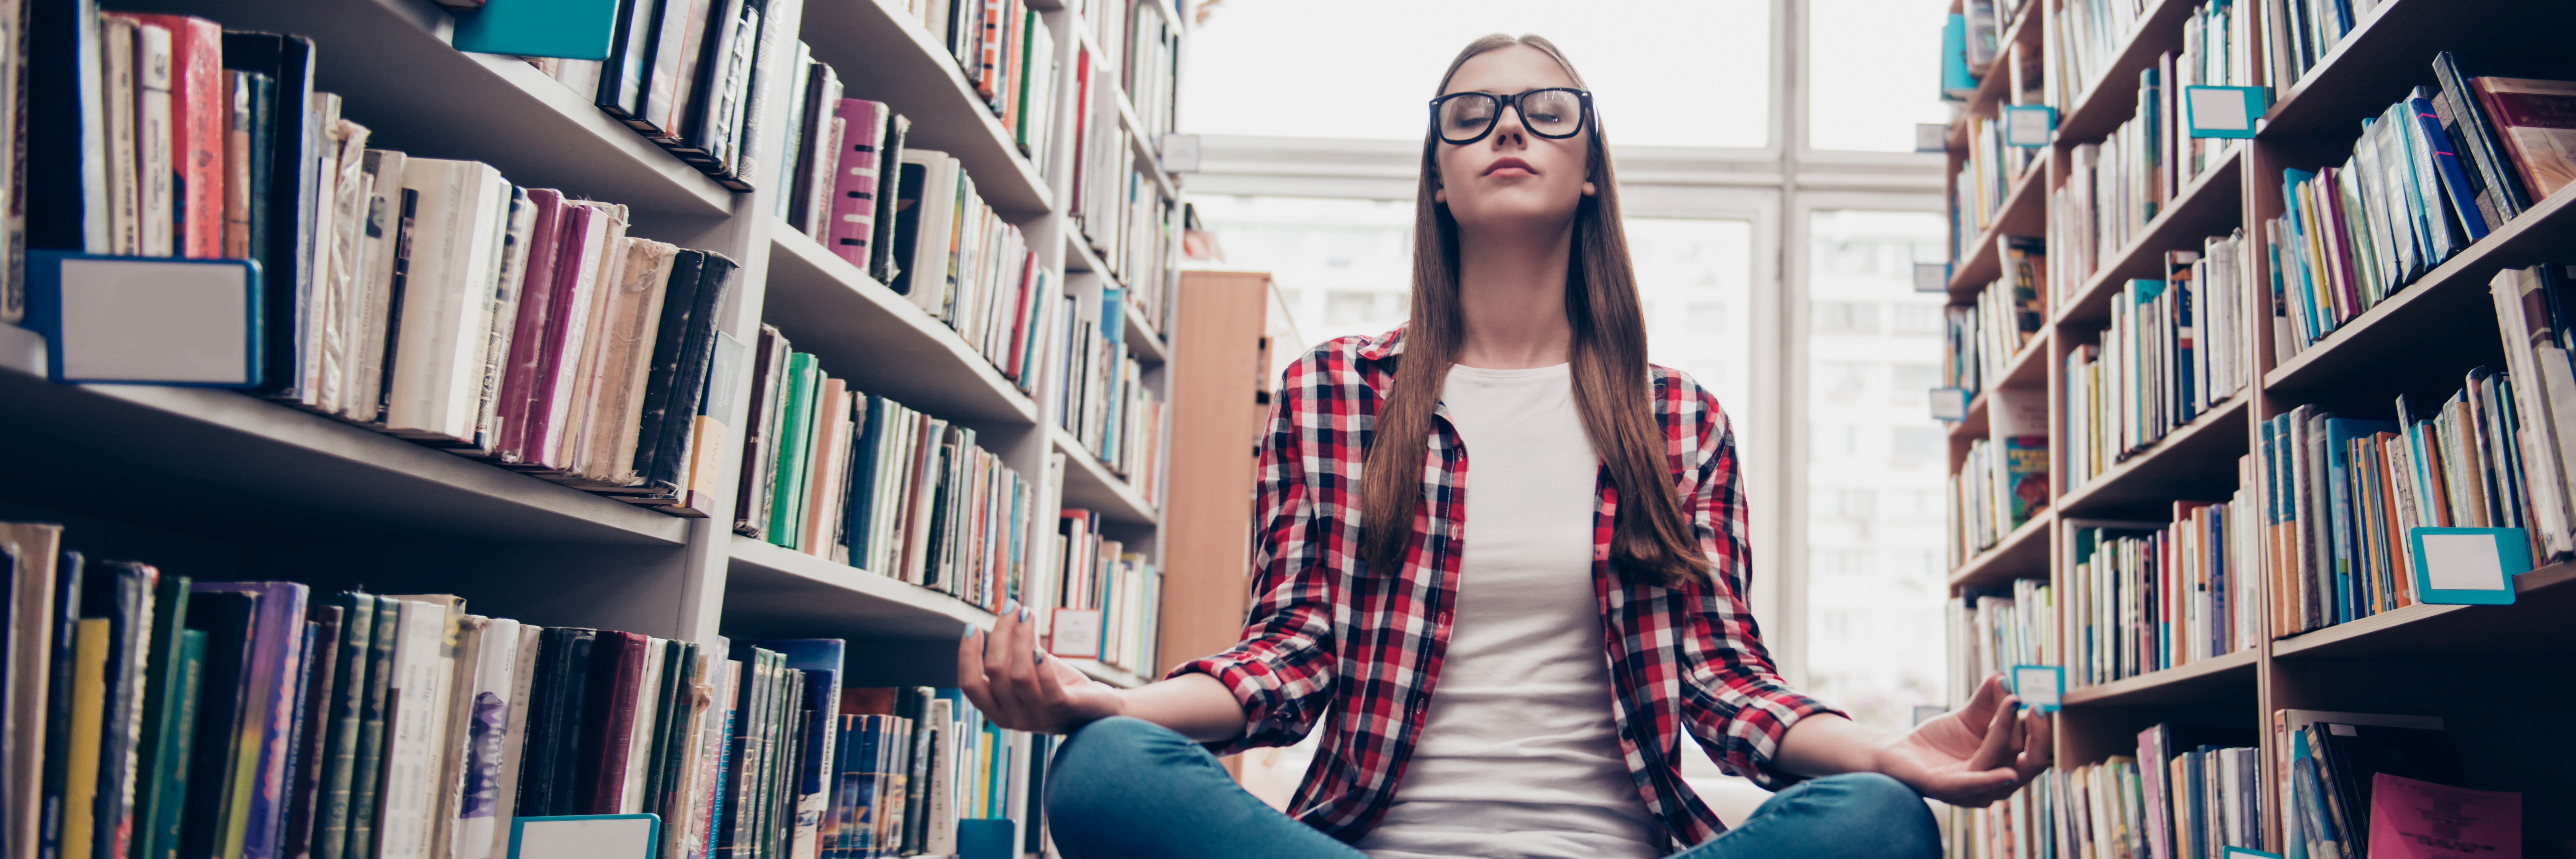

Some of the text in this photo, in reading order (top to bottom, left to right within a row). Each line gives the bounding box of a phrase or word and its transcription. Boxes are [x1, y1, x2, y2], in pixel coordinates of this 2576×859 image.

[565, 252, 595, 376] Йоганн Вольфганг ГЕТЕ
[710, 429, 722, 469] ГРАСС
[720, 713, 736, 772] ПІОНЕРИ
